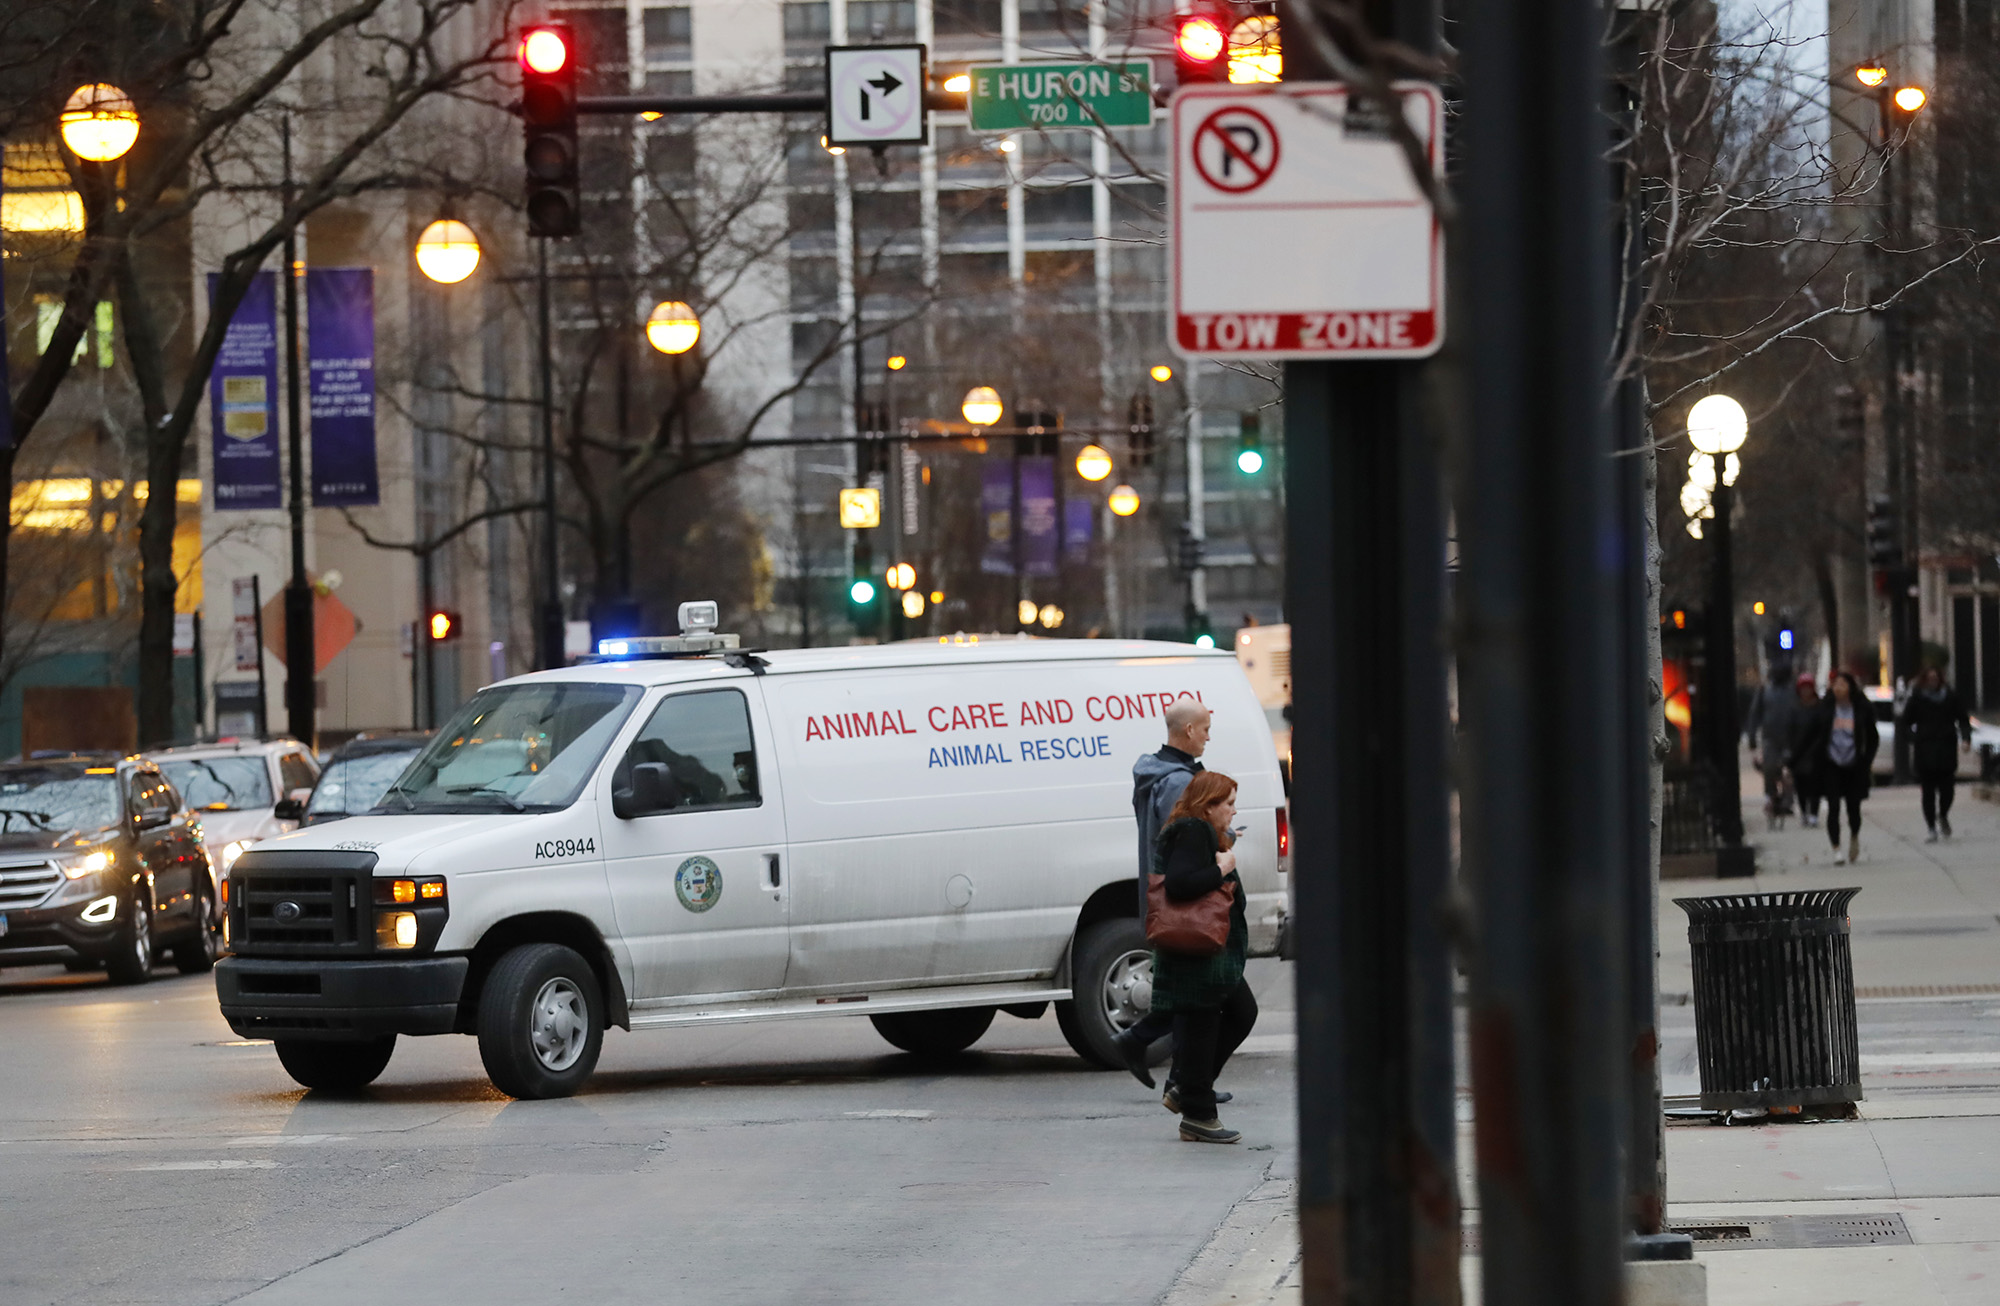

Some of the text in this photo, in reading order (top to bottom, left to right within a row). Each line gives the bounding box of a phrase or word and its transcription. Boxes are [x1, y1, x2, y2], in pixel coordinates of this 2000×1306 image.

[977, 78, 990, 97] E
[998, 70, 1110, 99] HURON
[1028, 103, 1068, 122] 700
[1190, 311, 1415, 350] TOW ZONE
[805, 710, 918, 742] ANIMAL
[928, 703, 1009, 733] CARE
[1020, 699, 1074, 727] AND
[928, 735, 1112, 768] ANIMAL RESCUE
[534, 837, 596, 859] AC8944
